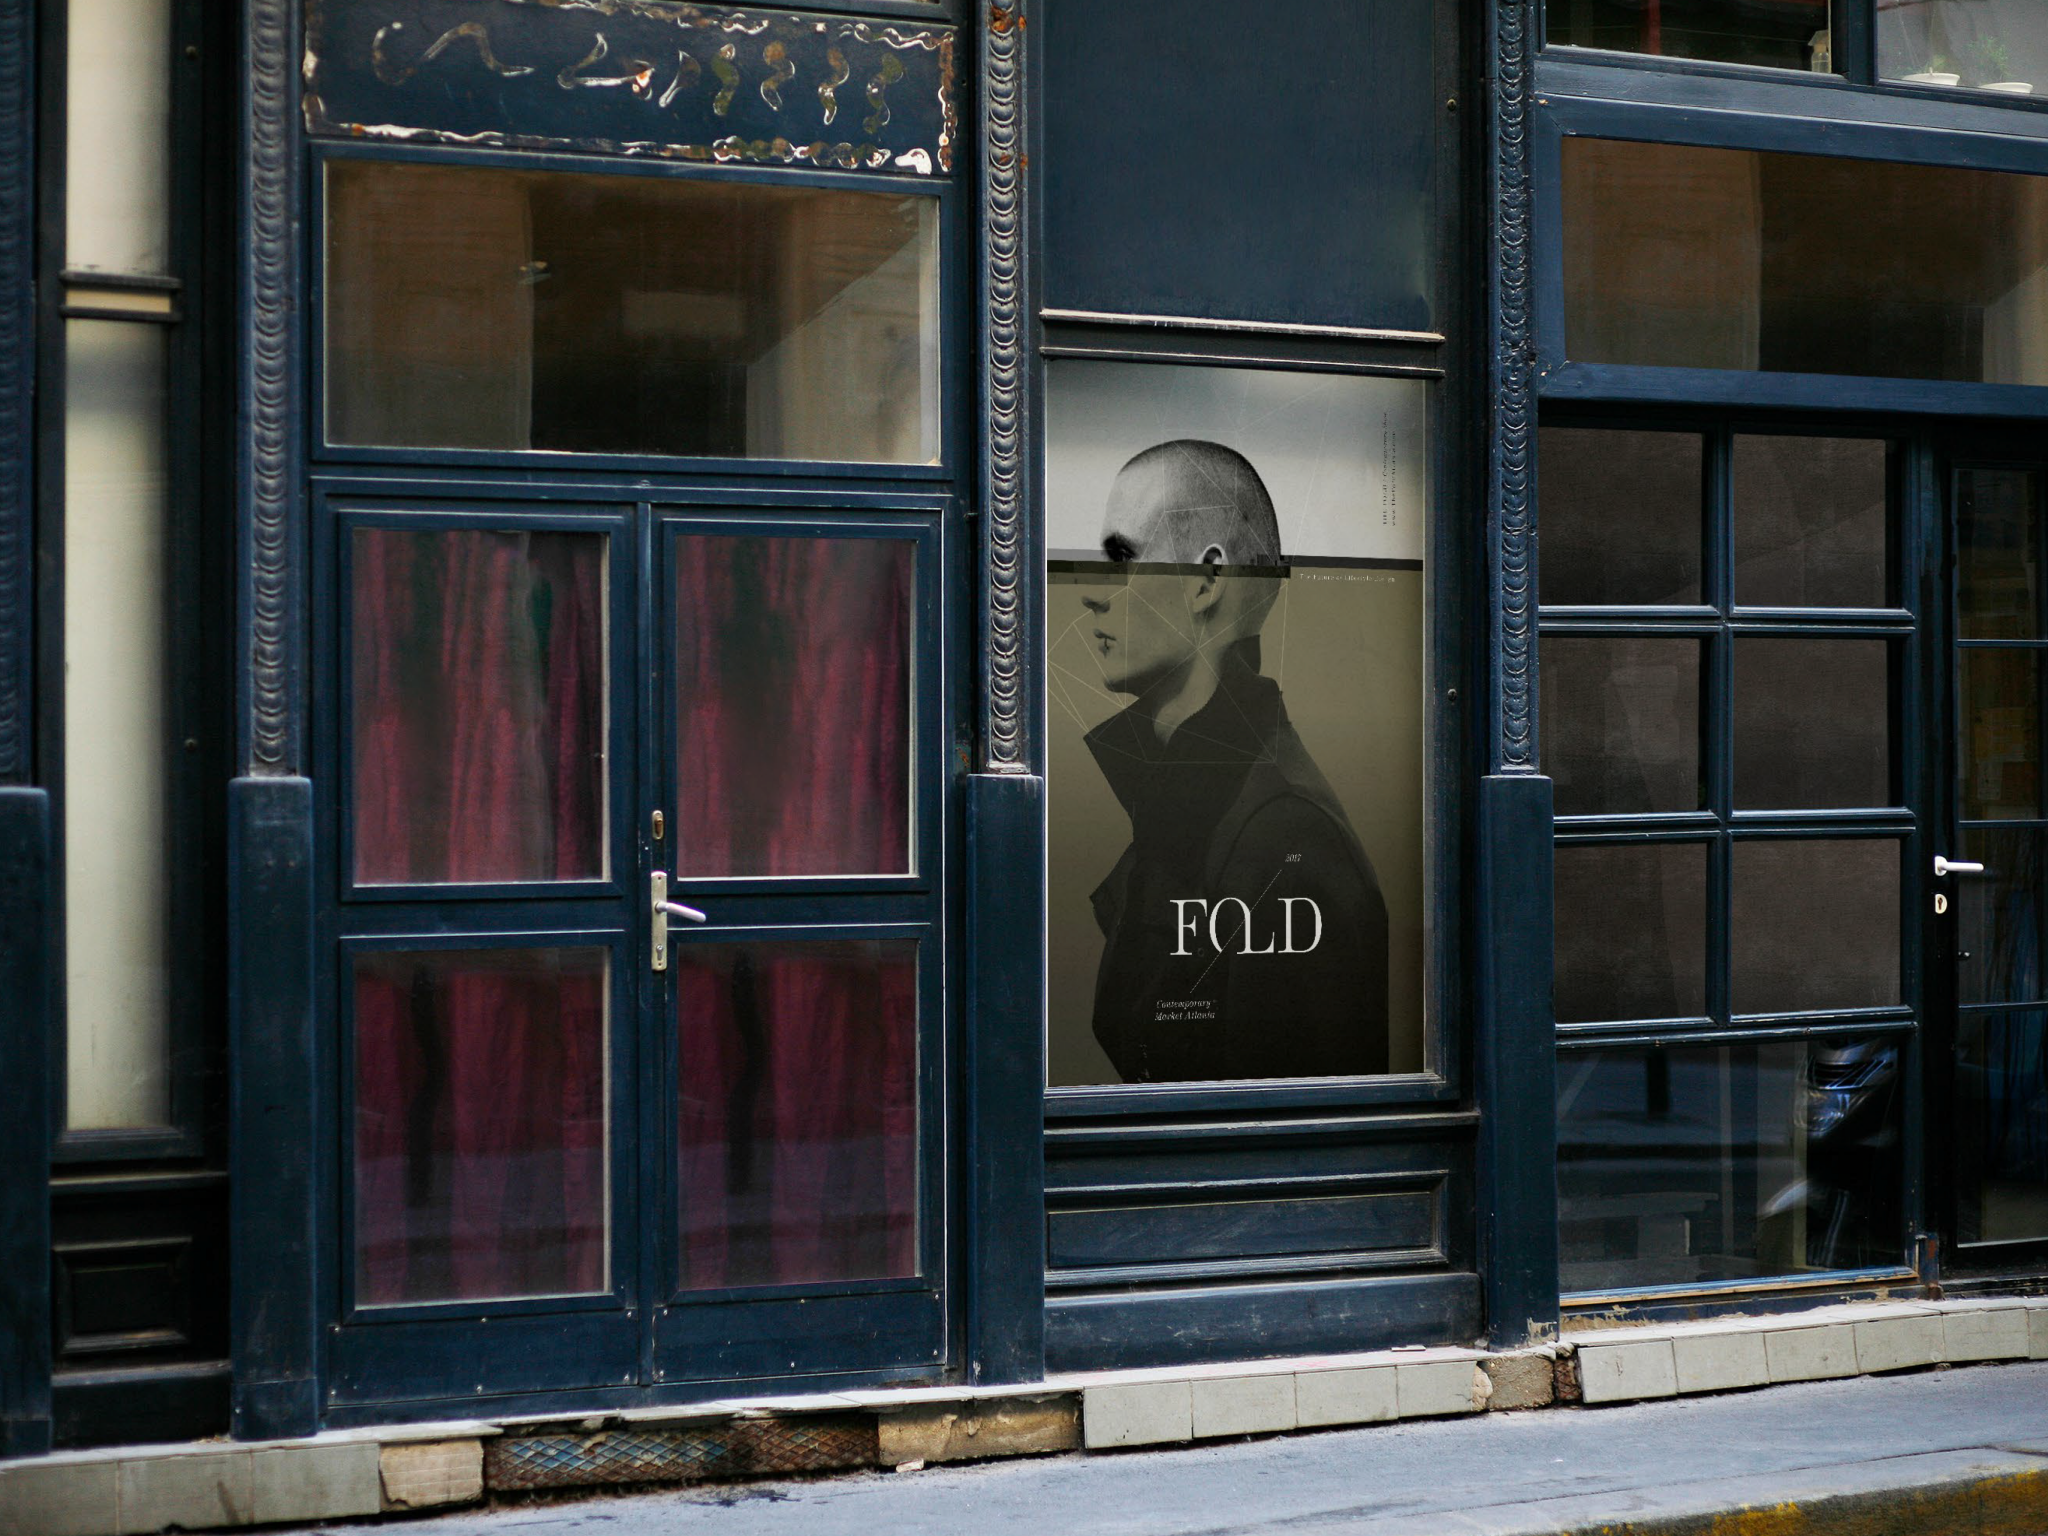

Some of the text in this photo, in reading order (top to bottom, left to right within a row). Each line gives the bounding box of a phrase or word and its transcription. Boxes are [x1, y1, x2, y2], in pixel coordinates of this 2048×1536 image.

[1284, 853, 1302, 862] 2017
[1170, 897, 1323, 956] FOLD
[1156, 1000, 1211, 1009] Contemporary
[1154, 1011, 1216, 1020] Market Atlanta
